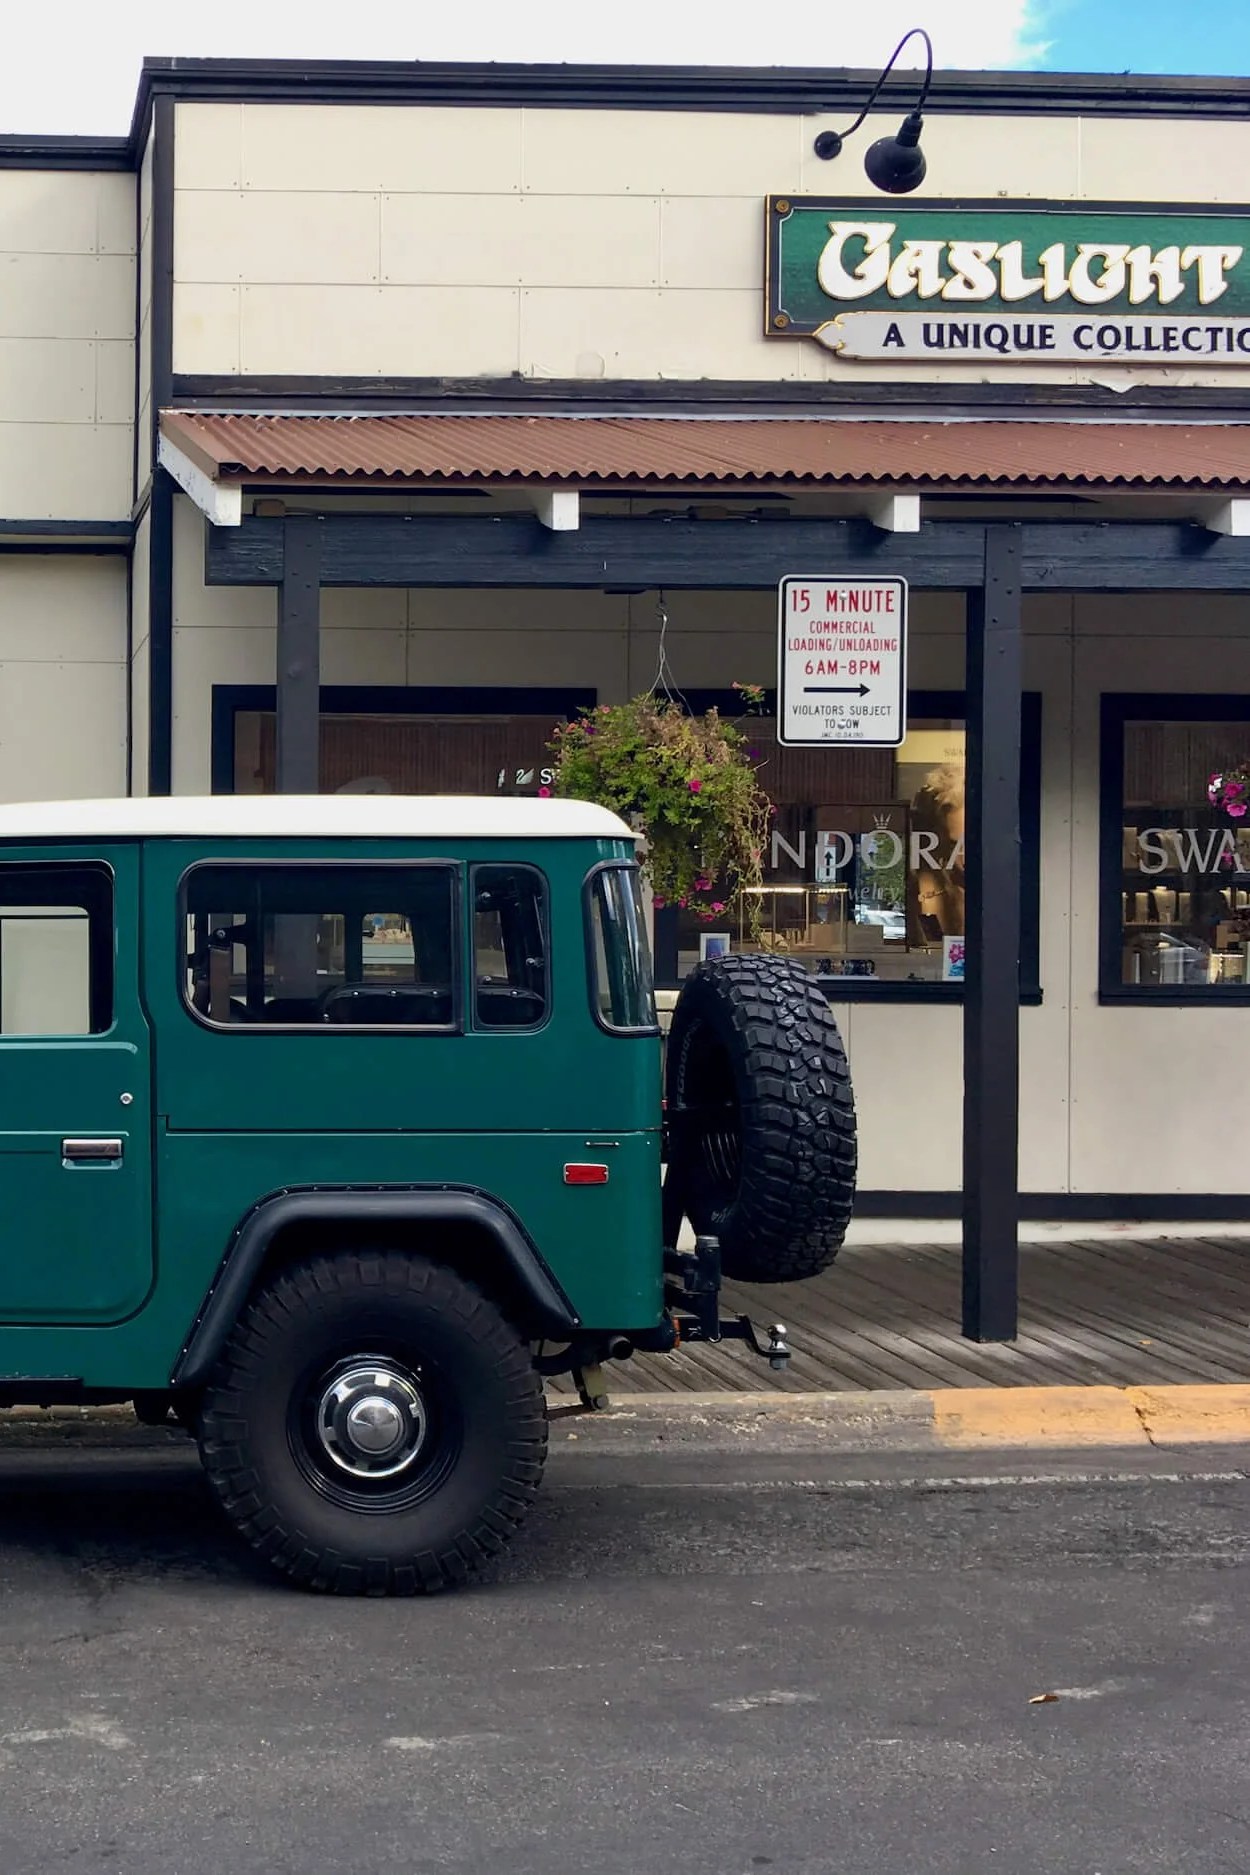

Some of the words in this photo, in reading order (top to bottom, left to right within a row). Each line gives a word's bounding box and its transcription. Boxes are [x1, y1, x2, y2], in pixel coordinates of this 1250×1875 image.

[882, 322, 906, 348] A
[922, 322, 1056, 353] UNIQUE
[792, 589, 811, 613] 15
[826, 589, 895, 613] MINUTE
[809, 620, 876, 634] COMMERCIAL
[788, 638, 898, 652] LOADING/UNLOADING
[804, 659, 881, 676] 6AM-8PM
[792, 705, 845, 716] VIOLATORS
[849, 705, 892, 716] SUBJECT
[824, 719, 836, 729] TO
